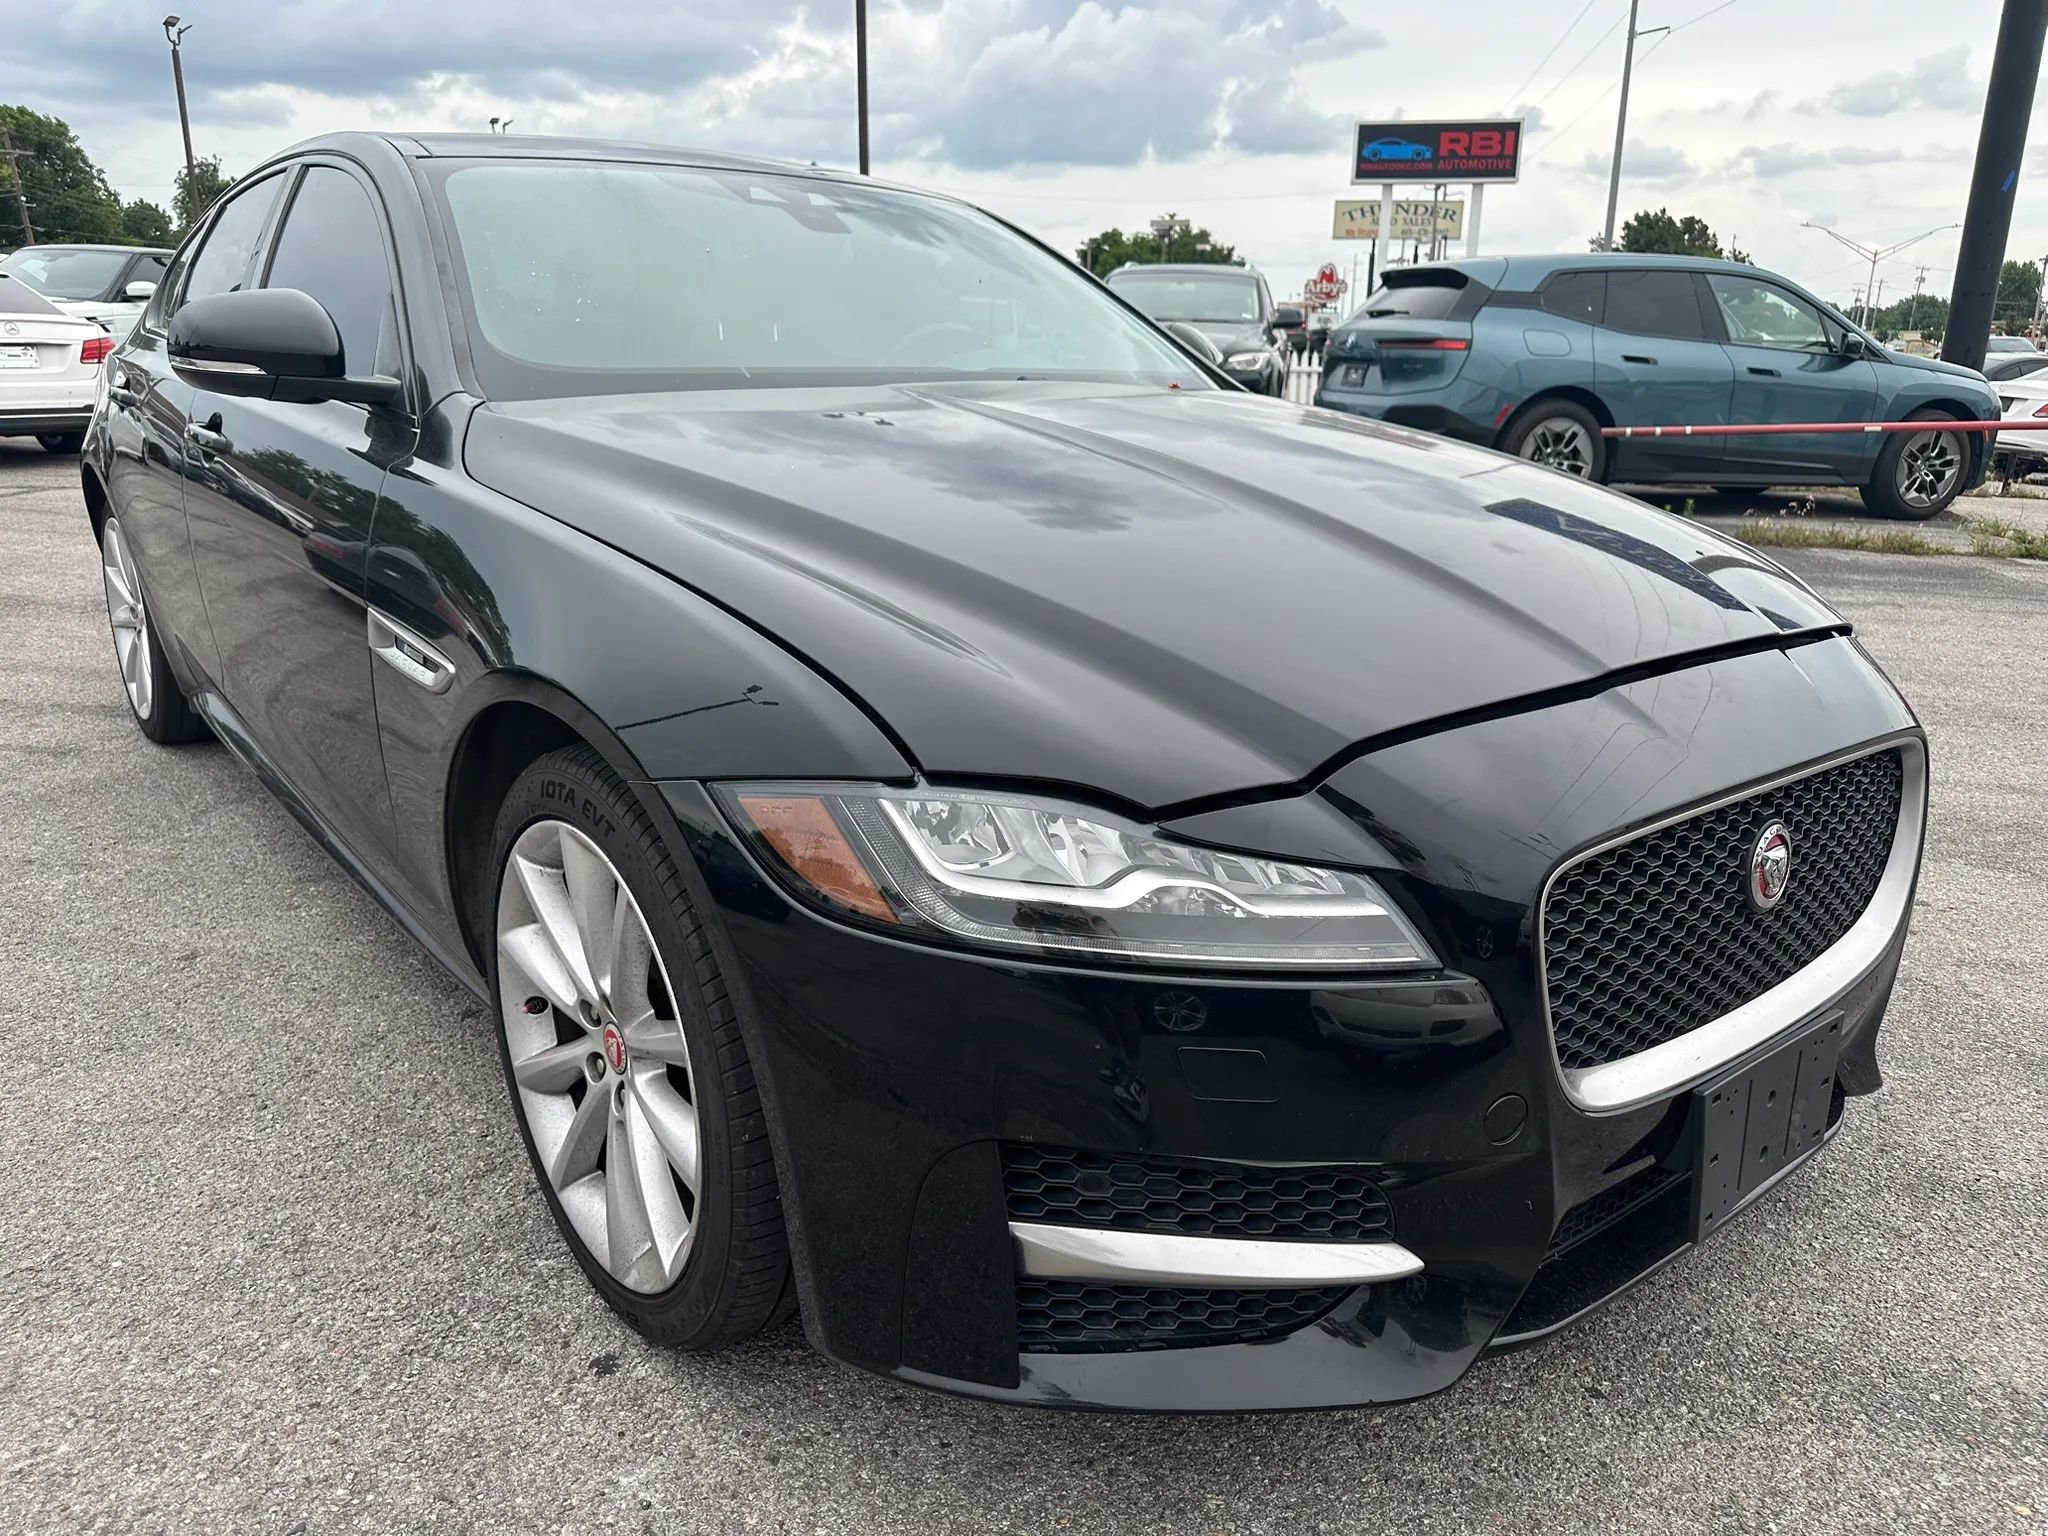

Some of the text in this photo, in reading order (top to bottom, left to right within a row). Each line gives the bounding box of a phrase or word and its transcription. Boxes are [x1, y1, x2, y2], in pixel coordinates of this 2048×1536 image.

[1439, 130, 1515, 157] RBI
[1438, 159, 1512, 170] AUTOMOTIVE
[1402, 216, 1432, 227] SALES
[1305, 279, 1348, 298] Arby's
[541, 779, 576, 808] IOTA
[582, 799, 616, 838] EVT
